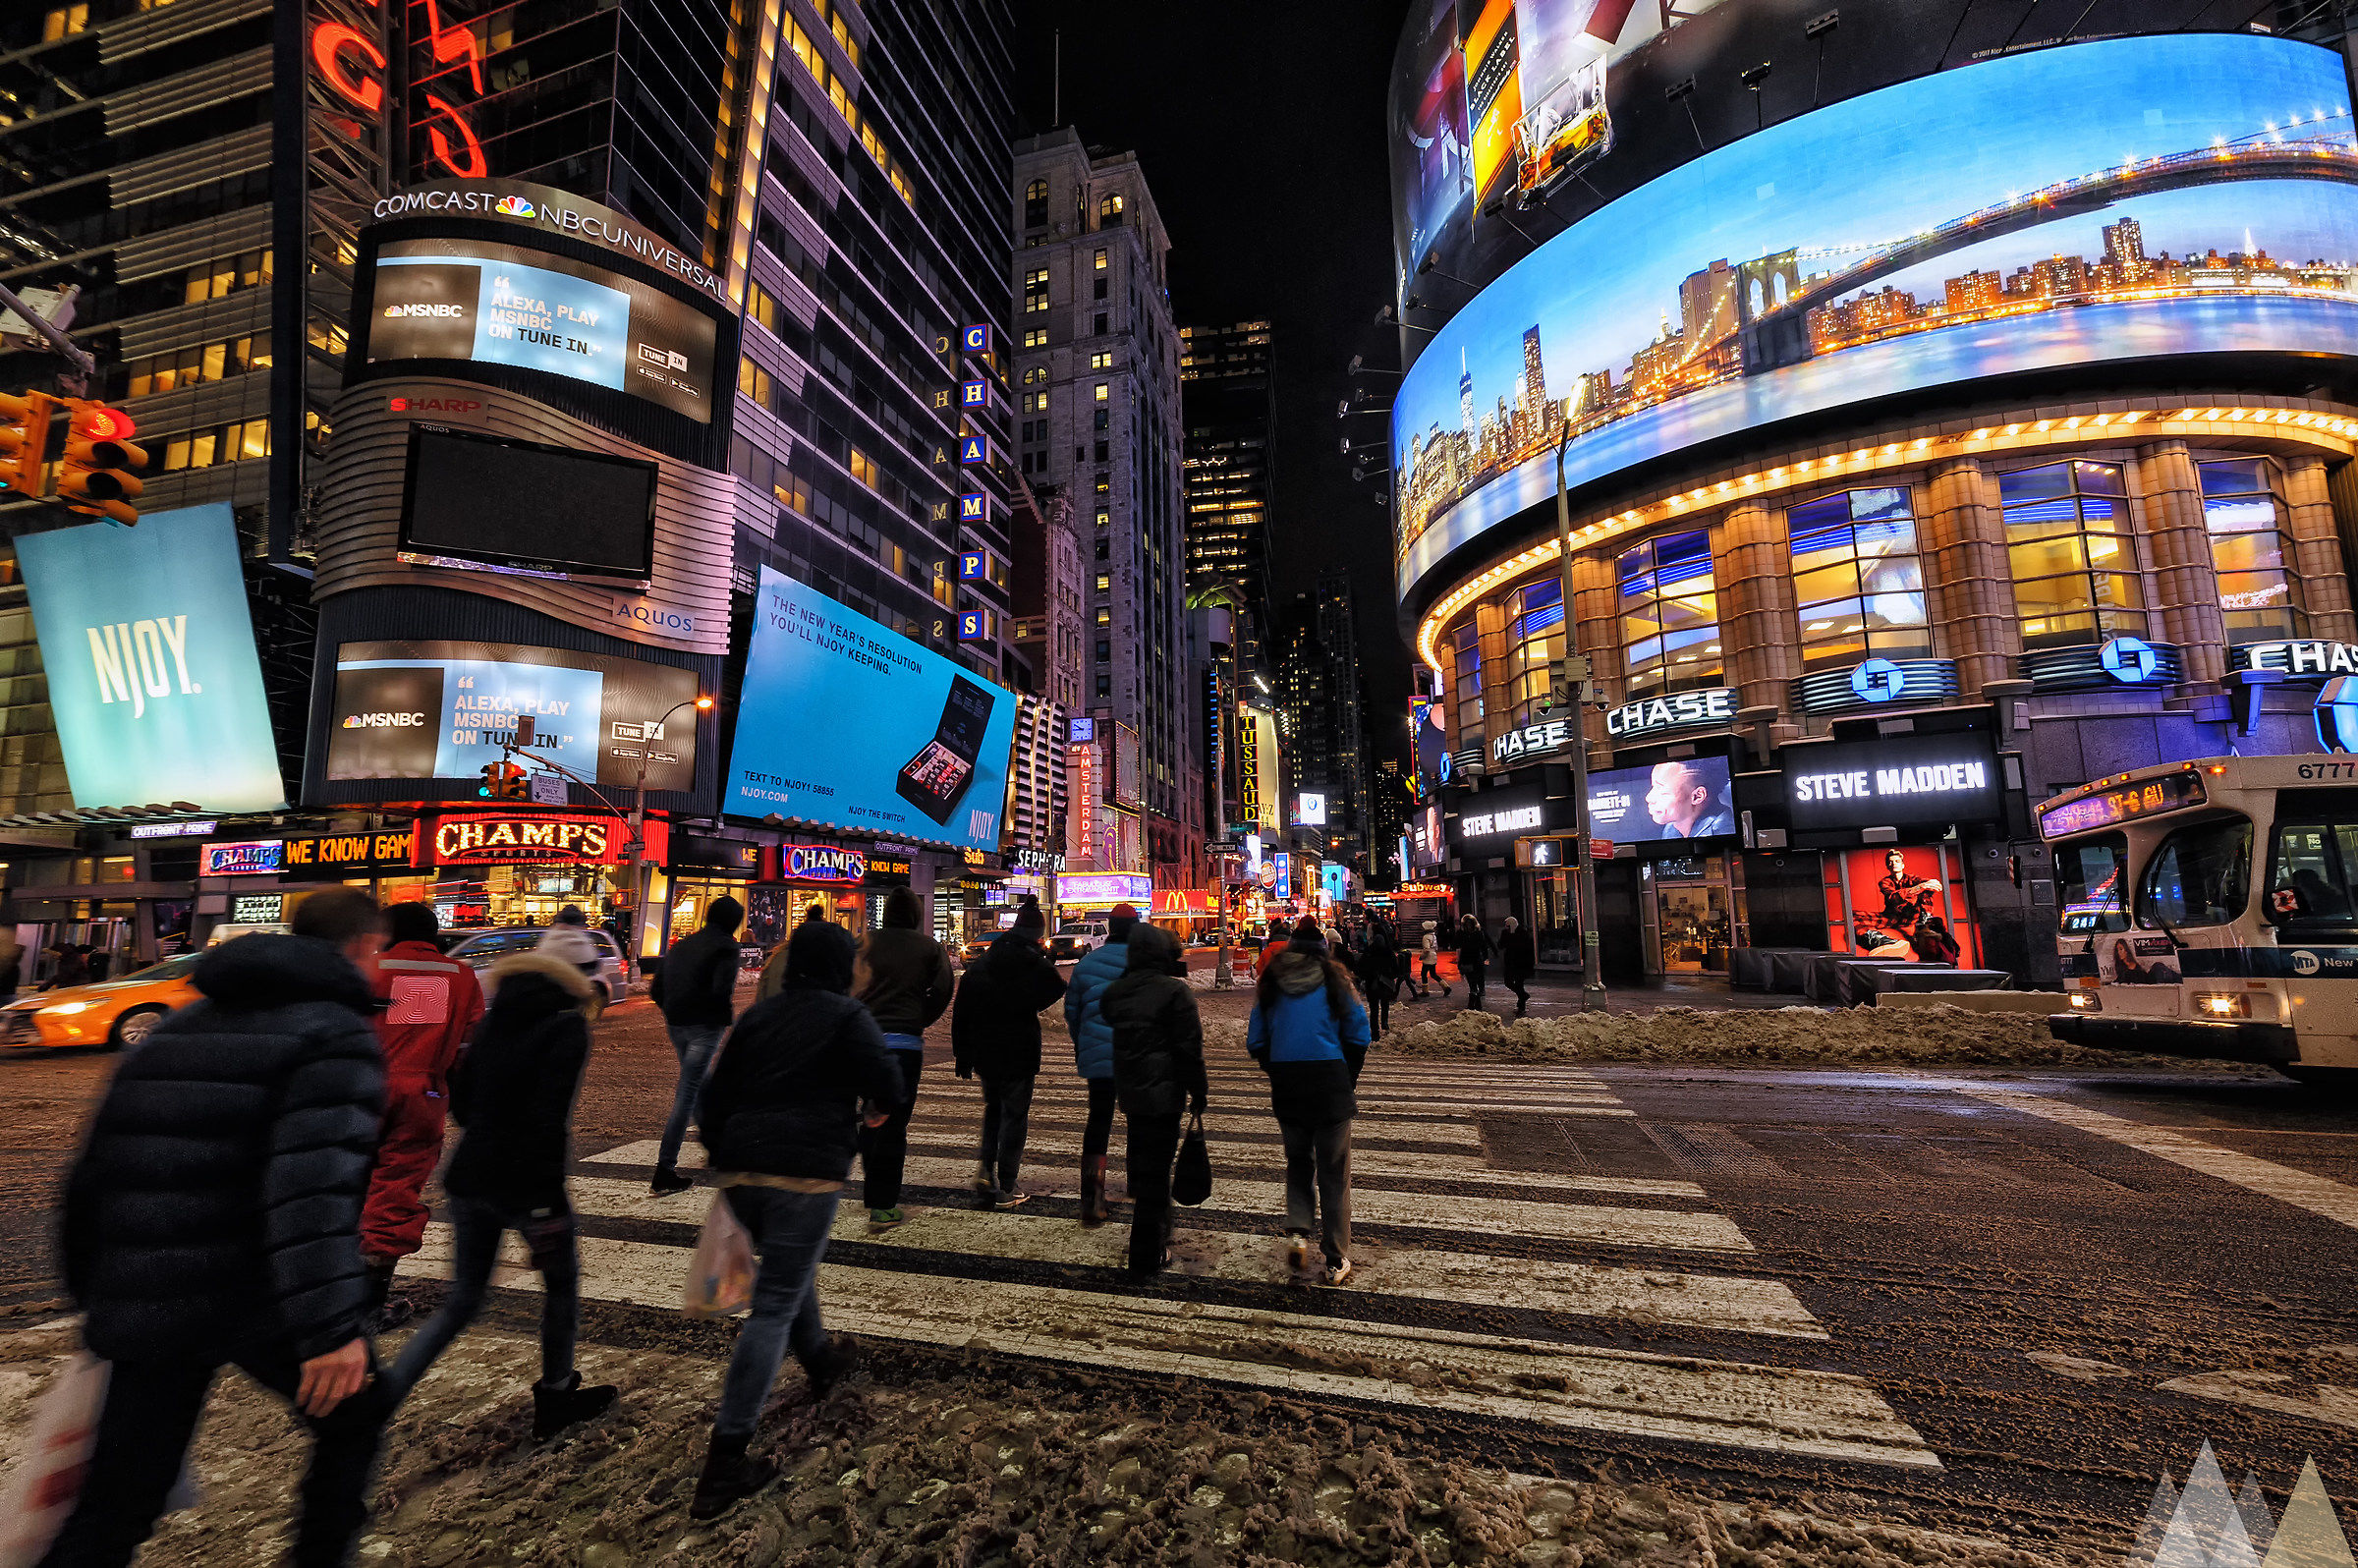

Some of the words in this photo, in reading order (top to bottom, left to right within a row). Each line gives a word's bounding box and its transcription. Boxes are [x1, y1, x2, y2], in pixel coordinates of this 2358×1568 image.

[1470, 74, 1491, 111] BLACK
[1490, 36, 1515, 73] LABEL
[374, 191, 494, 218] COMCAST
[540, 203, 726, 303] NBCUNIVERSAL
[402, 304, 463, 318] MSNBC
[490, 295, 553, 317] ALEXA,
[557, 305, 600, 328] PLAY
[490, 308, 553, 331] MSNBC
[488, 323, 513, 341] ON
[517, 327, 562, 349] TUNE
[644, 348, 666, 364] TUNE
[672, 356, 683, 366] IN
[390, 398, 481, 414] SHARP
[420, 423, 450, 433] AQUOS
[616, 602, 694, 632] AQUOS
[770, 612, 813, 643] YOU'LL
[815, 636, 845, 658] NJOY
[848, 649, 892, 676] KEEPING.
[772, 594, 797, 616] THE
[800, 607, 826, 629] NEW
[829, 621, 866, 647] YEAR'S
[868, 640, 923, 675] RESOLUTION
[455, 694, 520, 713] ALEXA,
[524, 699, 571, 717] PLAY
[1606, 689, 1735, 736] CHASE
[362, 711, 424, 728] MSNBC
[454, 712, 519, 729] MSNBC
[451, 729, 477, 746] ON
[481, 731, 533, 748] TUN
[618, 727, 641, 738] TUNE
[1493, 720, 1568, 761] CHASE
[537, 776, 560, 787] BUSES
[1795, 771, 1871, 801] STEVE
[1877, 761, 1986, 795] MADDEN
[2297, 762, 2356, 779] 6777
[540, 787, 558, 796] ONLY
[744, 769, 767, 784] TEXT
[770, 774, 782, 786] TO
[813, 783, 835, 797] 58855
[741, 786, 788, 804] NJOY.COM
[1081, 745, 1093, 857] AMSTERDAM
[848, 805, 866, 817] NJOY
[868, 809, 881, 819] THE
[881, 812, 905, 824] SWITCH
[1462, 814, 1493, 837] STEVE
[1494, 806, 1543, 831] MADDEN
[133, 823, 184, 837] OUTFRONT
[186, 822, 213, 834] PRIME
[969, 810, 994, 843] NJOY
[286, 840, 313, 865] WE
[318, 836, 368, 862] KNOW
[373, 833, 414, 860] GAM
[436, 823, 607, 857] CHAMPS
[209, 846, 282, 871] CHAMPS
[480, 849, 552, 859] SPORTS
[742, 847, 758, 863] WE
[789, 848, 865, 877] CHAMPS
[870, 860, 890, 873] KNOW
[892, 863, 910, 874] GAME
[1401, 882, 1447, 893] Subway
[2324, 957, 2353, 968] New
